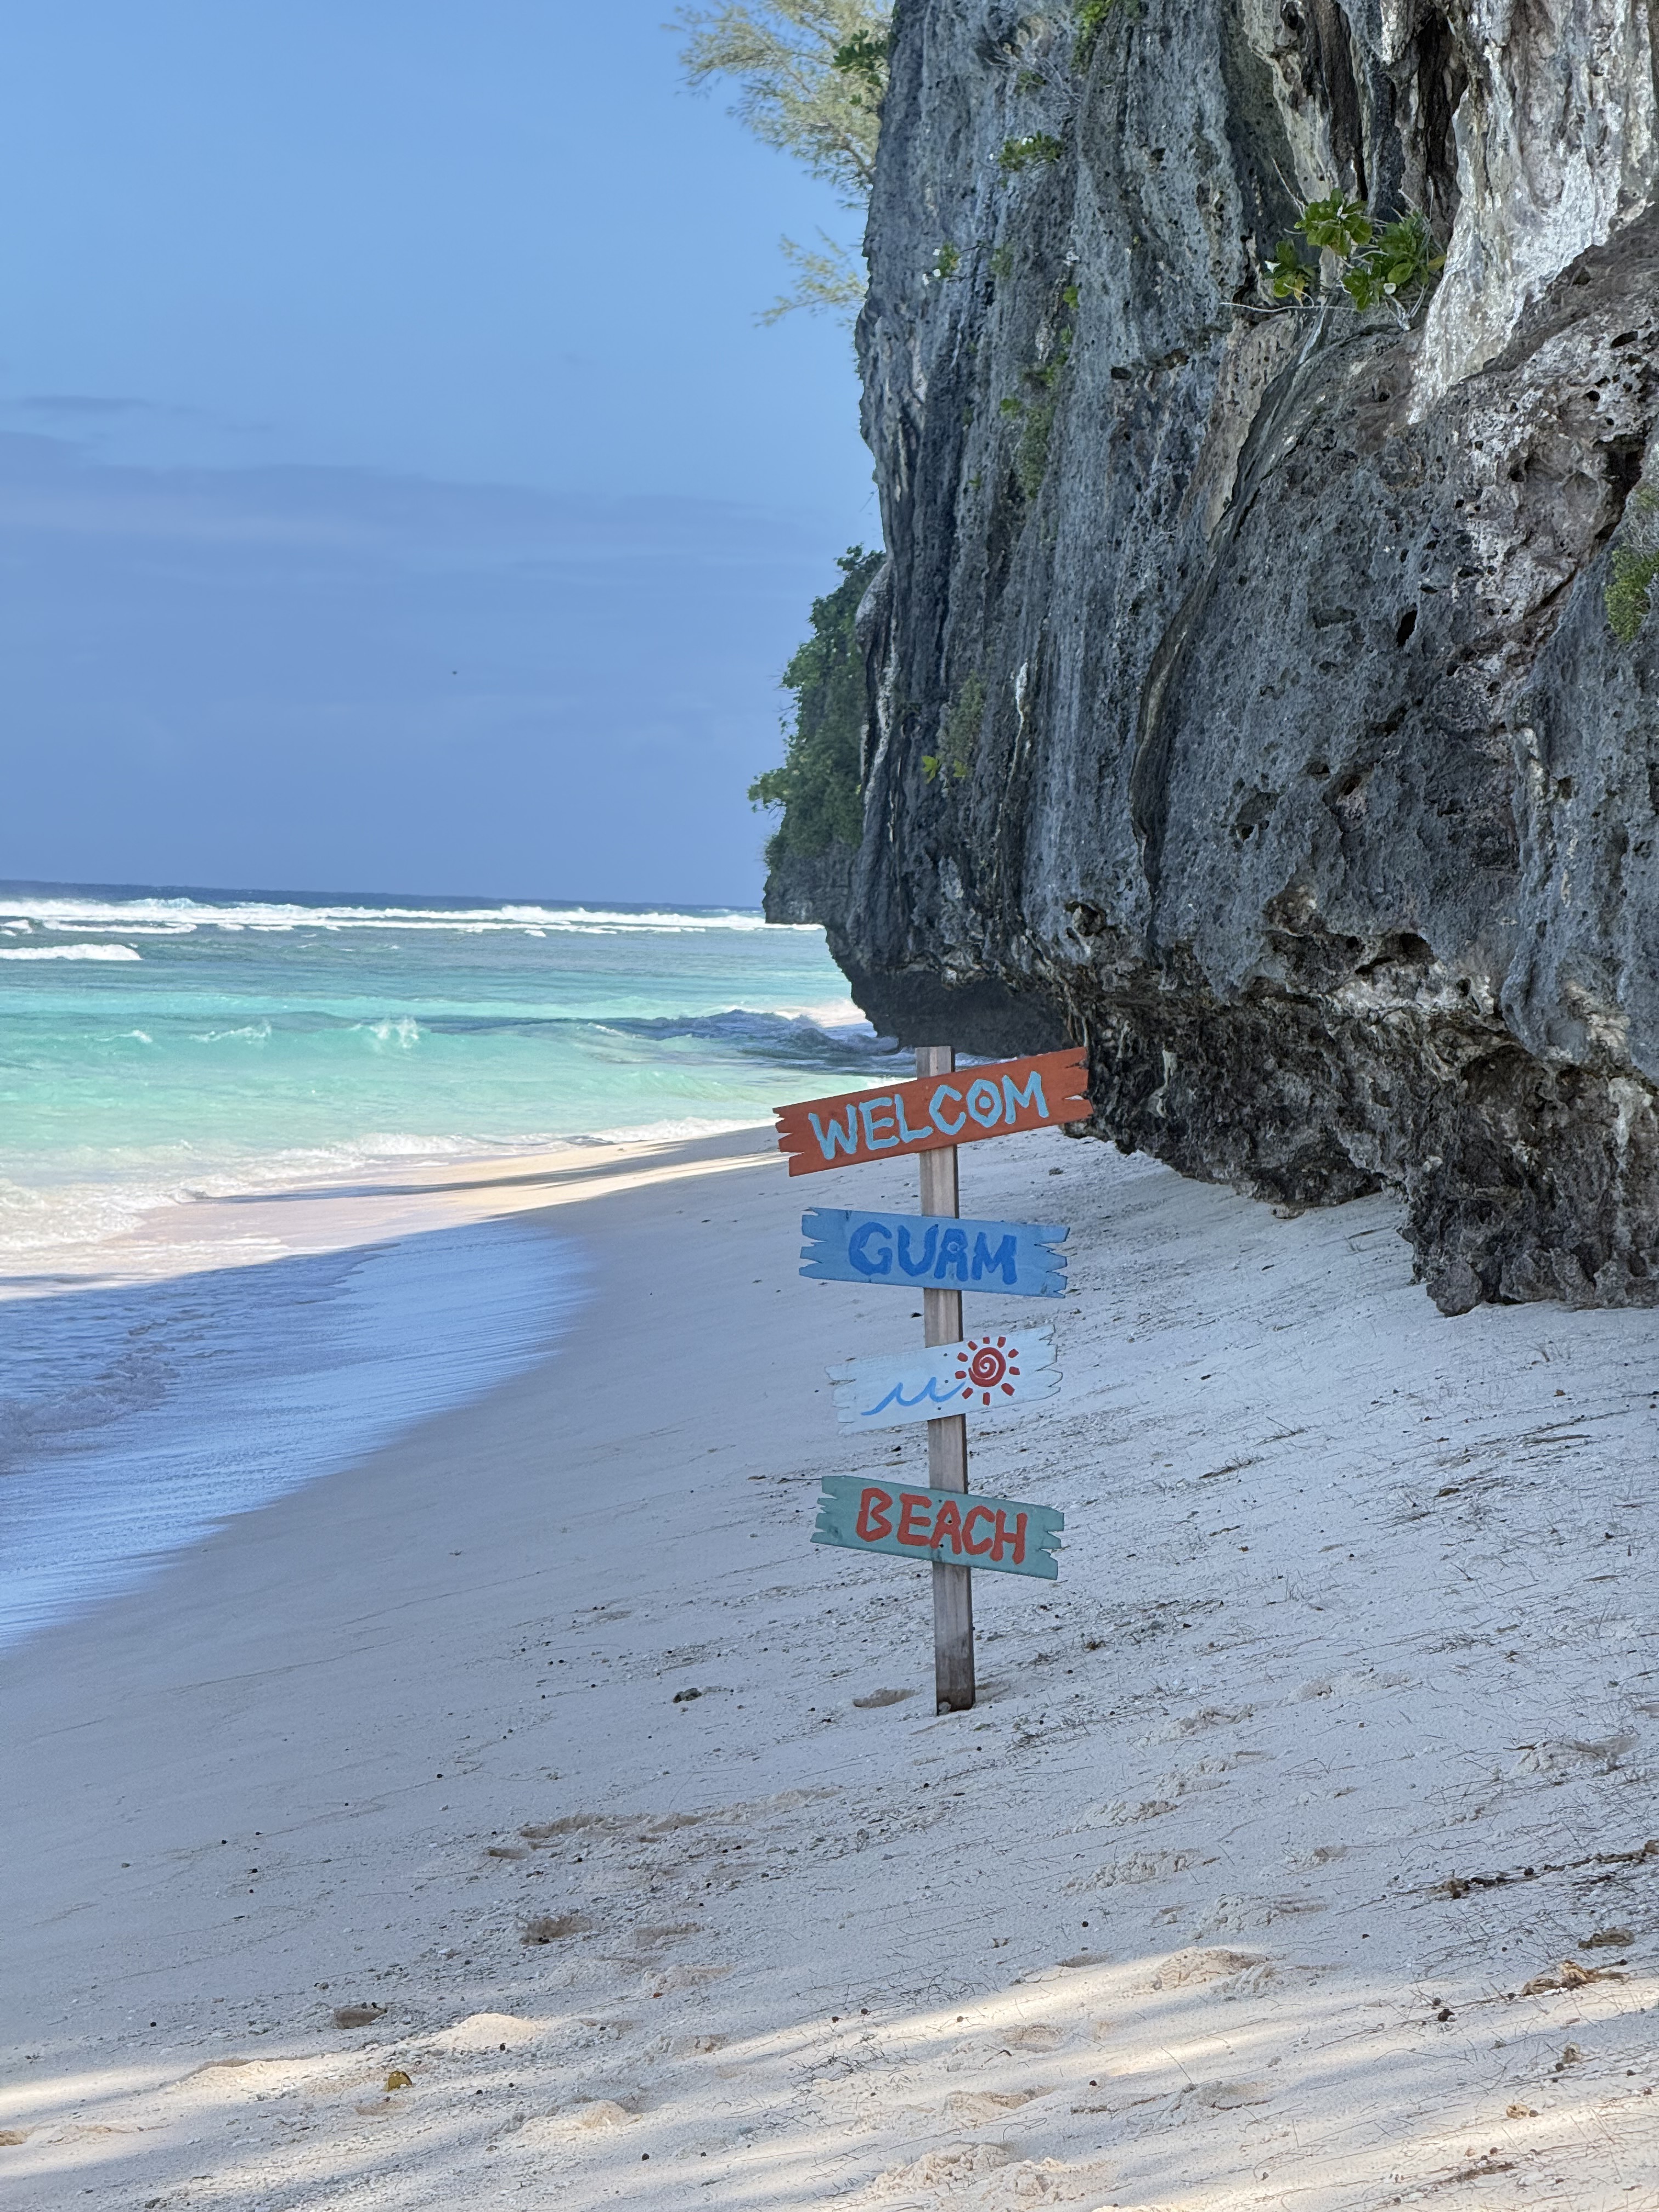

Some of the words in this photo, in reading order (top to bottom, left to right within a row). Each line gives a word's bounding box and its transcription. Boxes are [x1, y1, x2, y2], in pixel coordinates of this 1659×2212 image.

[808, 1071, 1049, 1160] WELCOM
[848, 1222, 1017, 1284] GUAM
[855, 1487, 1028, 1565] BEACH
